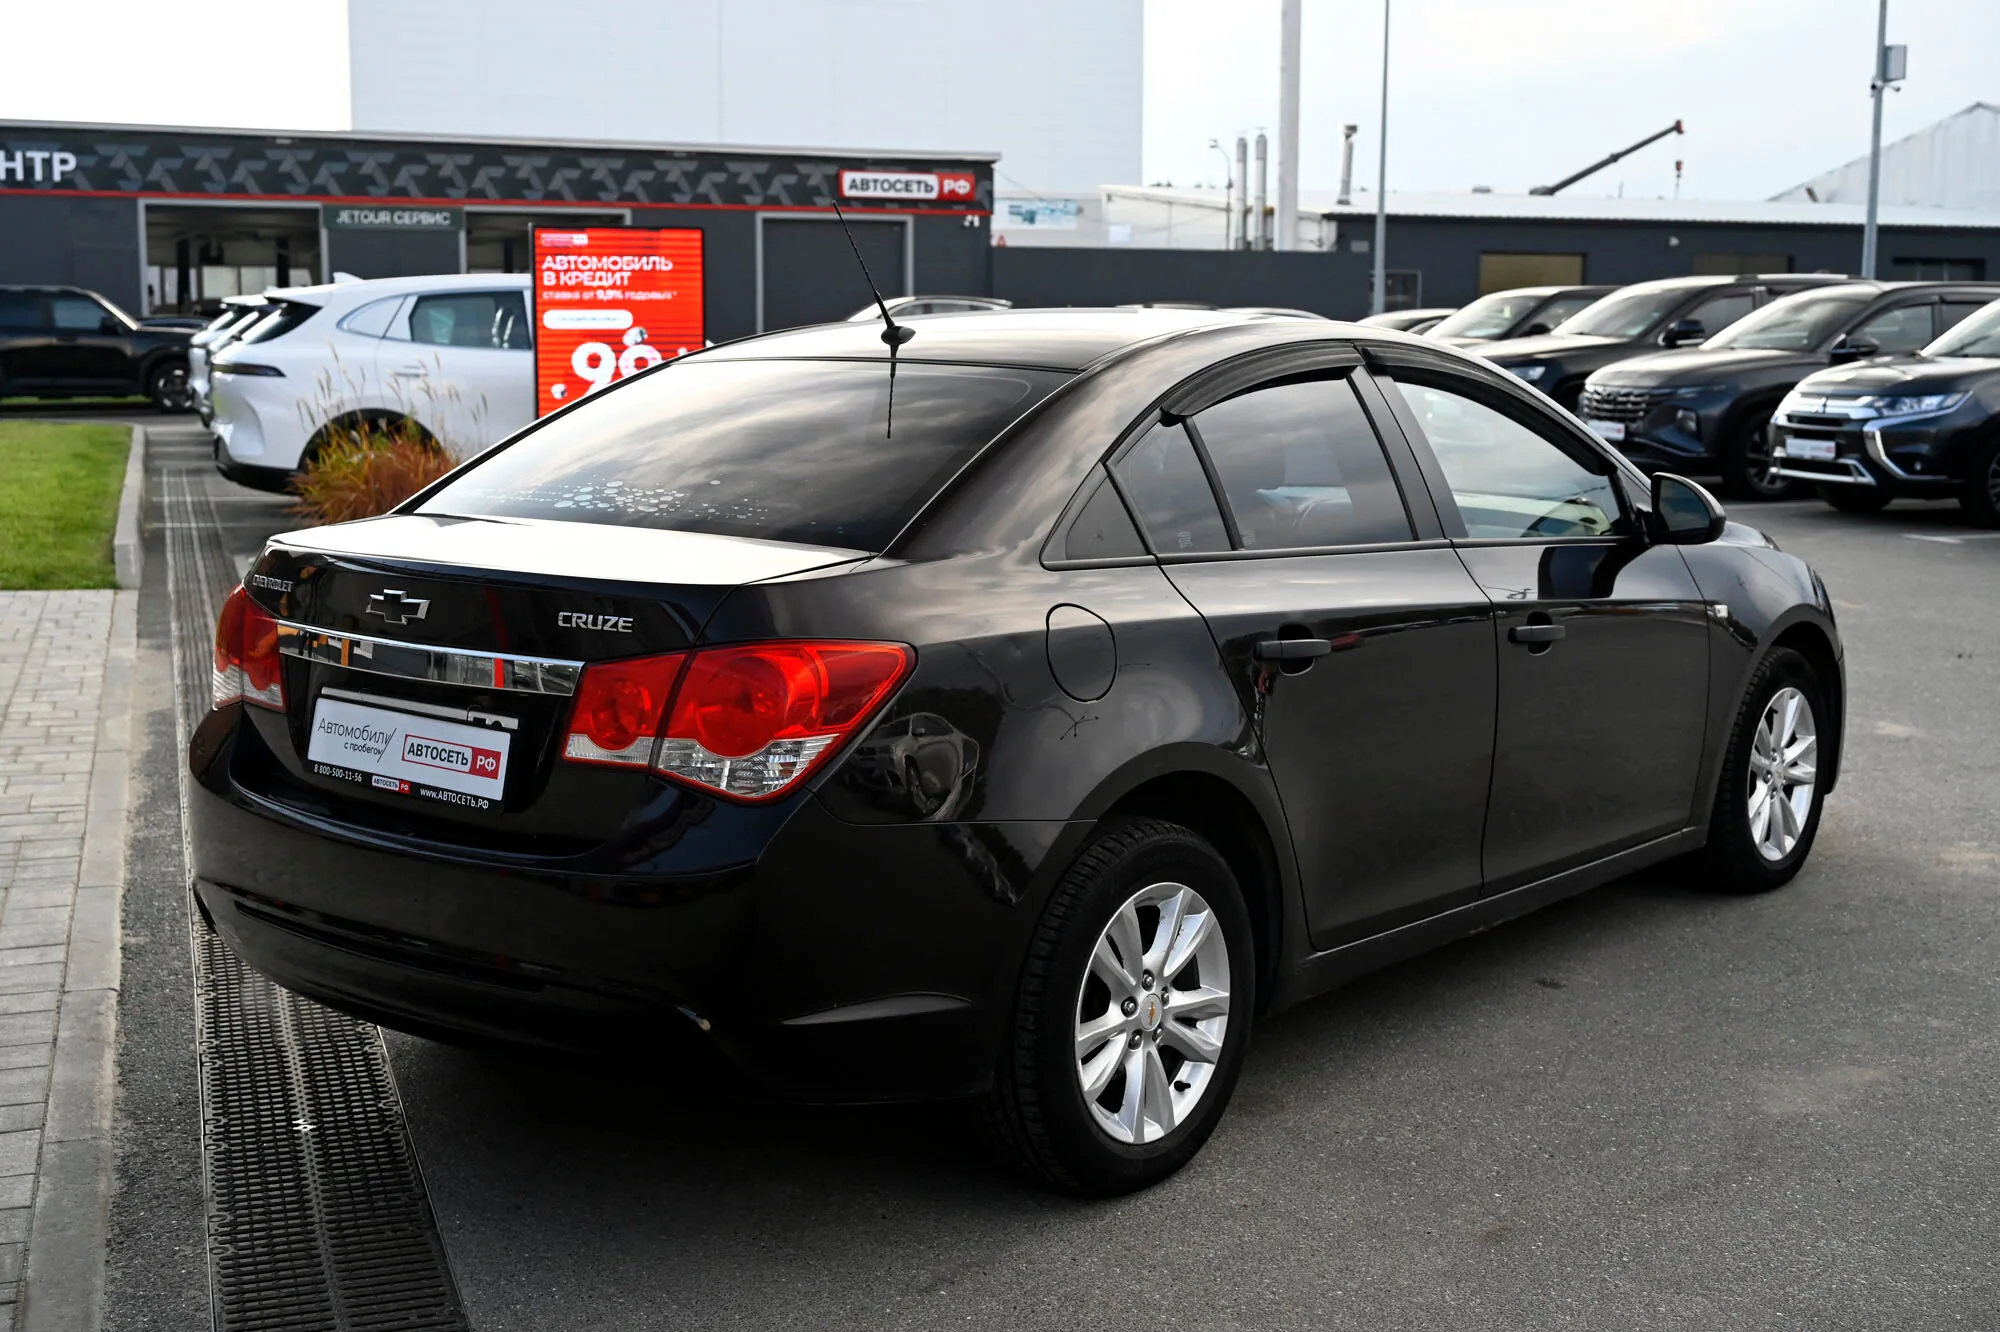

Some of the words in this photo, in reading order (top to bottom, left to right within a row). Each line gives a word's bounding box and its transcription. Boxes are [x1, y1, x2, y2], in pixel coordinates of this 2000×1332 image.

[0, 149, 77, 182] НТР
[848, 177, 935, 194] АВТОСЕТЬ
[943, 179, 971, 195] РФ
[336, 210, 392, 224] JETOUR
[393, 210, 451, 225] СЕРВИС
[542, 255, 673, 271] АВТОМОБИЛЬ
[543, 271, 557, 286] В
[560, 271, 632, 288] КРЕДИТ
[558, 611, 634, 632] CRUZE
[349, 742, 383, 755] пробегом
[407, 742, 468, 766] АВТОСЕТЬ
[476, 755, 497, 771] РФ
[313, 763, 318, 773] 8
[319, 764, 362, 782] 800-500-11-56
[373, 777, 398, 789] АВТОСЕТЬ
[401, 783, 409, 791] РФ
[420, 788, 489, 809] www.АВТОСЕТЬ.РФ
